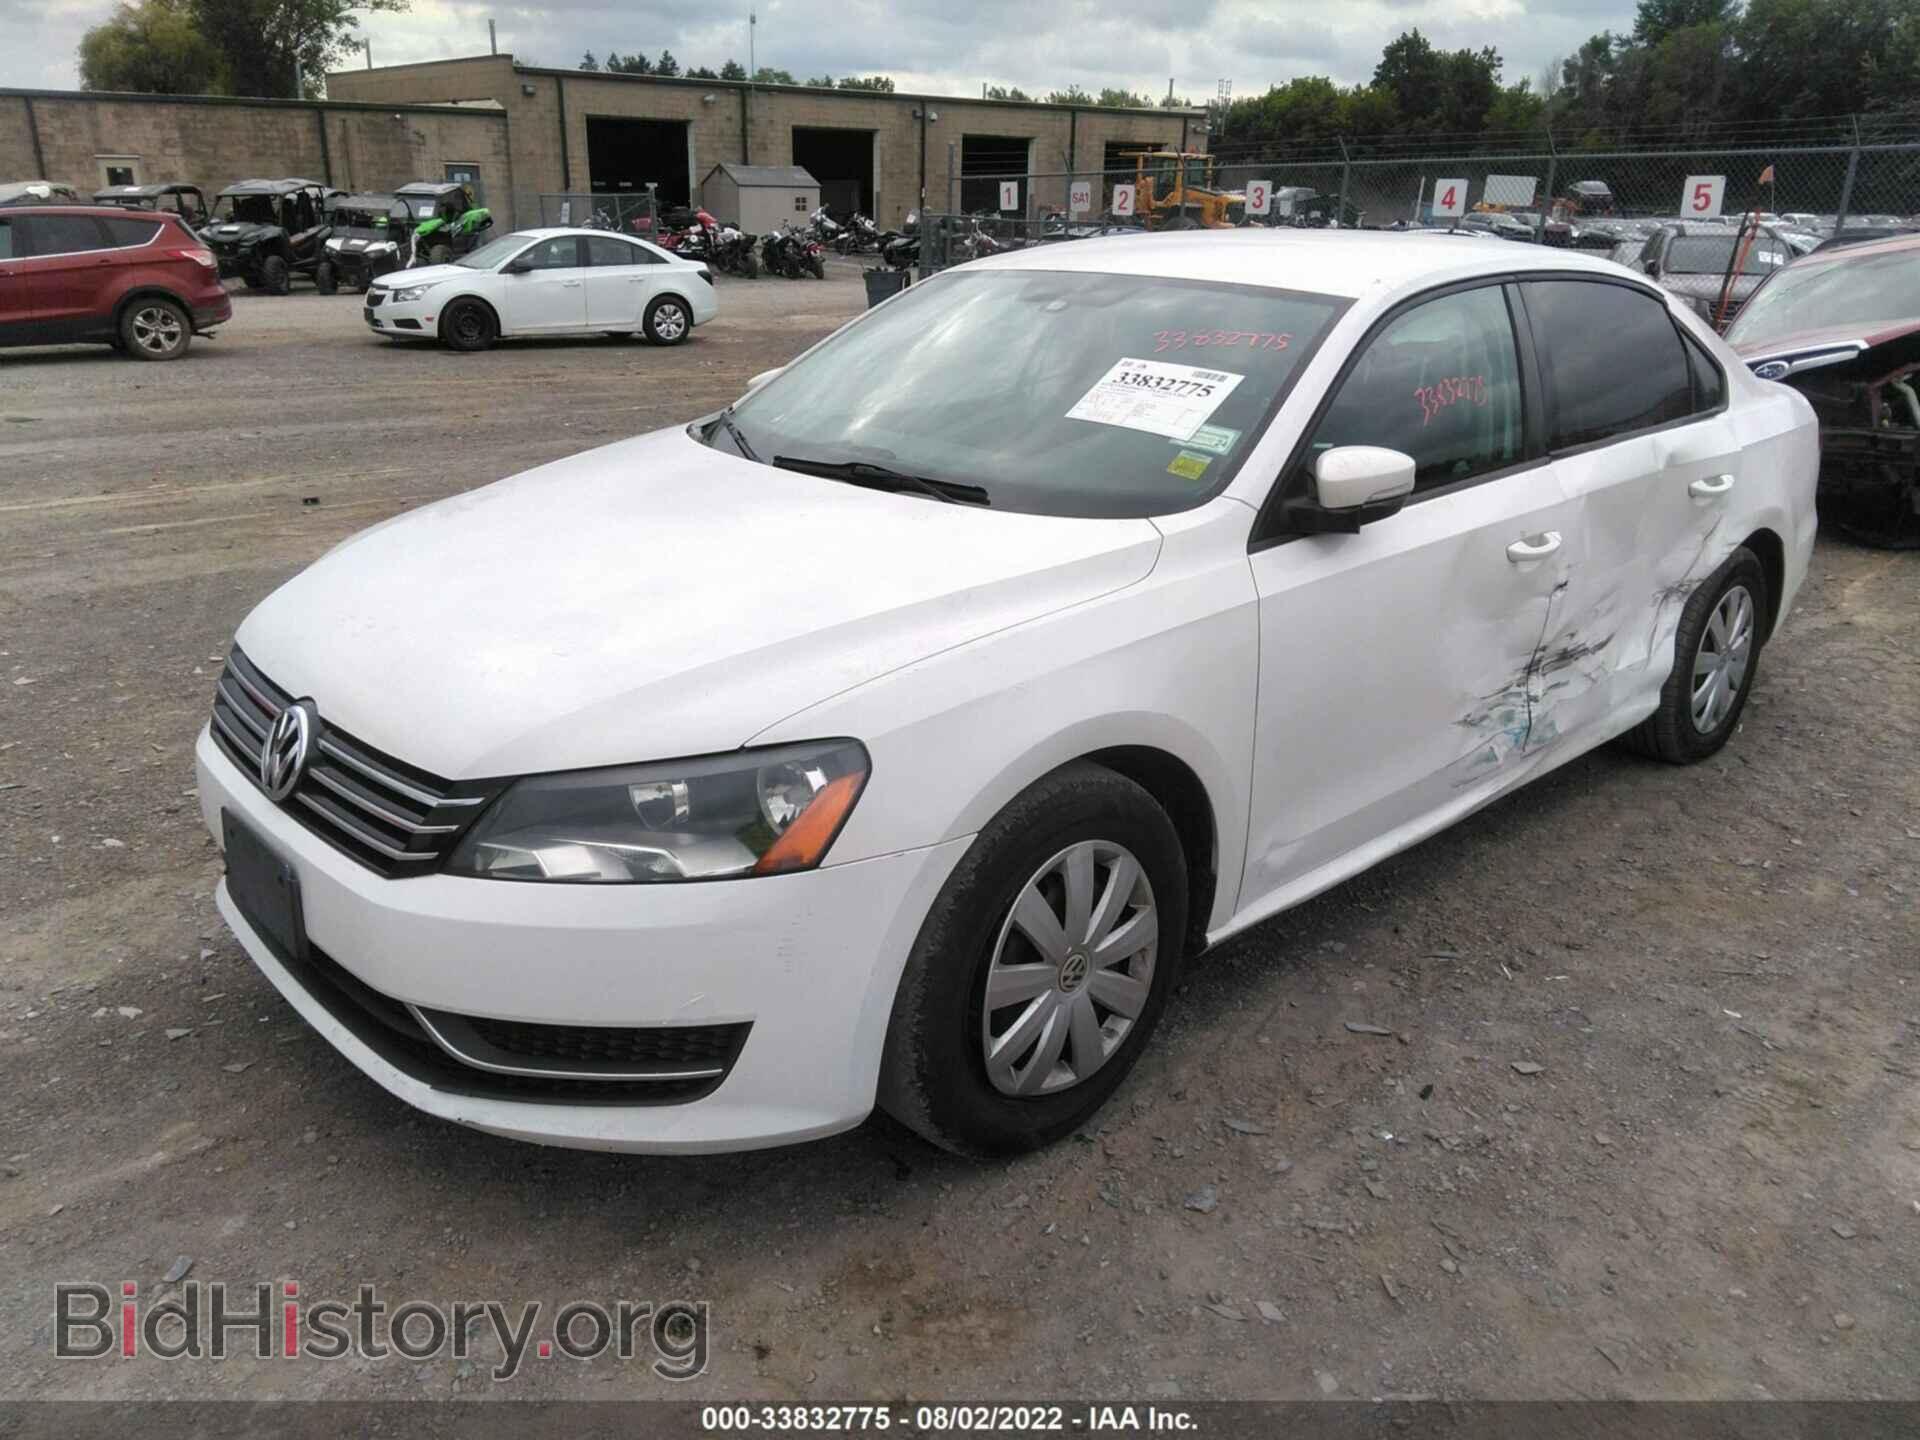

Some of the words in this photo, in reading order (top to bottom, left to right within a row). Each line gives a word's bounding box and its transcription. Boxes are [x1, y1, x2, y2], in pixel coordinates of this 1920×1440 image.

[1005, 187, 1012, 206] 1
[1071, 191, 1089, 204] SA1
[1118, 190, 1129, 210] 2
[1251, 186, 1265, 209] 3
[1440, 186, 1456, 209] 4
[1692, 183, 1713, 212] 5
[1112, 371, 1217, 398] 33832775
